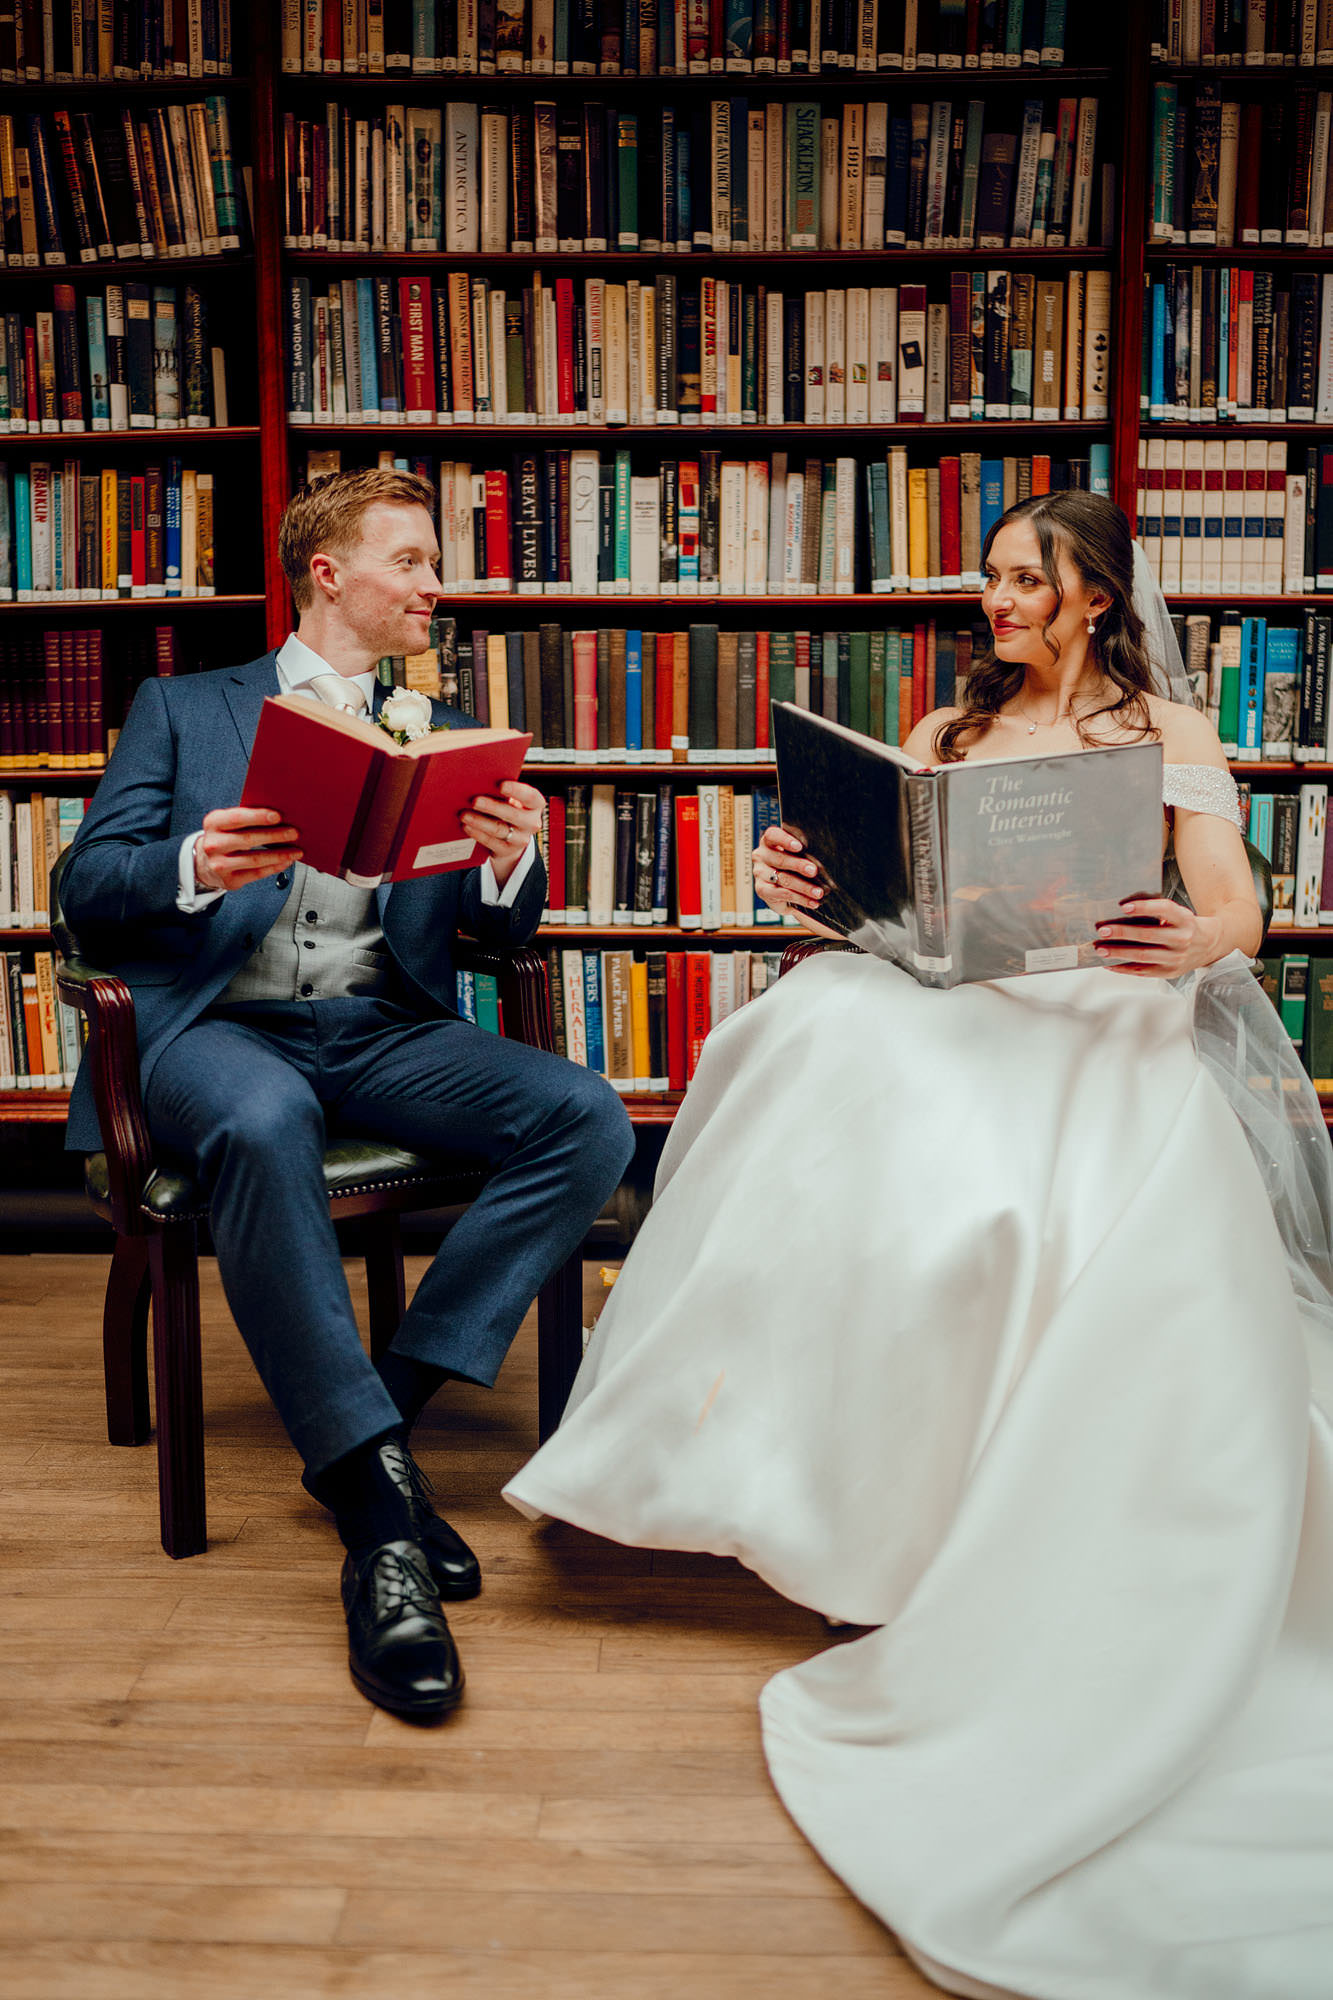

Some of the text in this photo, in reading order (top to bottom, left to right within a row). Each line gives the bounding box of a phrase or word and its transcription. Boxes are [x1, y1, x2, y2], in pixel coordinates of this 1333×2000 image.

[539, 113, 553, 176] NANSEN
[716, 103, 730, 201] SCOTT ANTARCTIC
[795, 108, 817, 194] SHACKLETON
[846, 146, 861, 179] 1912
[935, 140, 946, 169] FIENNES
[1165, 112, 1176, 197] TOM HOLLAND
[455, 130, 468, 234] ANTARCTICA
[379, 284, 392, 354] BUZZ ALDRIN
[437, 304, 447, 338] WINDOW
[456, 276, 470, 326] PAVILIONS
[589, 286, 602, 318] ALISTAIR
[191, 294, 204, 367] CONGO JOURNEY
[291, 287, 304, 368] SNOW WIDOWS
[408, 303, 424, 361] FIRST MAN
[590, 319, 602, 344] HORNE
[439, 347, 447, 362] THE
[459, 344, 471, 365] THE
[42, 363, 56, 419] Blood River
[460, 366, 472, 403] HEART
[33, 468, 49, 524] FRANKLIN
[575, 461, 596, 532] LOST
[618, 463, 628, 531] QUENTIN BELL
[520, 460, 538, 579] GREAT LIVES
[1315, 655, 1326, 674] LIKE
[1317, 632, 1327, 653] WAR
[1315, 675, 1325, 691] NO
[1313, 691, 1324, 724] OTHER
[977, 789, 1073, 817] Romantic
[986, 775, 1024, 795] The
[988, 810, 1065, 834] Interior
[1016, 829, 1073, 845] Wainwright
[918, 839, 932, 857] The
[919, 858, 935, 902] Romantic
[922, 903, 937, 937] Interior
[584, 956, 599, 1002] BREWERS
[718, 961, 729, 984] THE
[551, 978, 565, 1030] HERALDIC
[611, 957, 623, 1038] PALACE PAPERS
[694, 959, 706, 1037] THE MOUNTBATTENS
